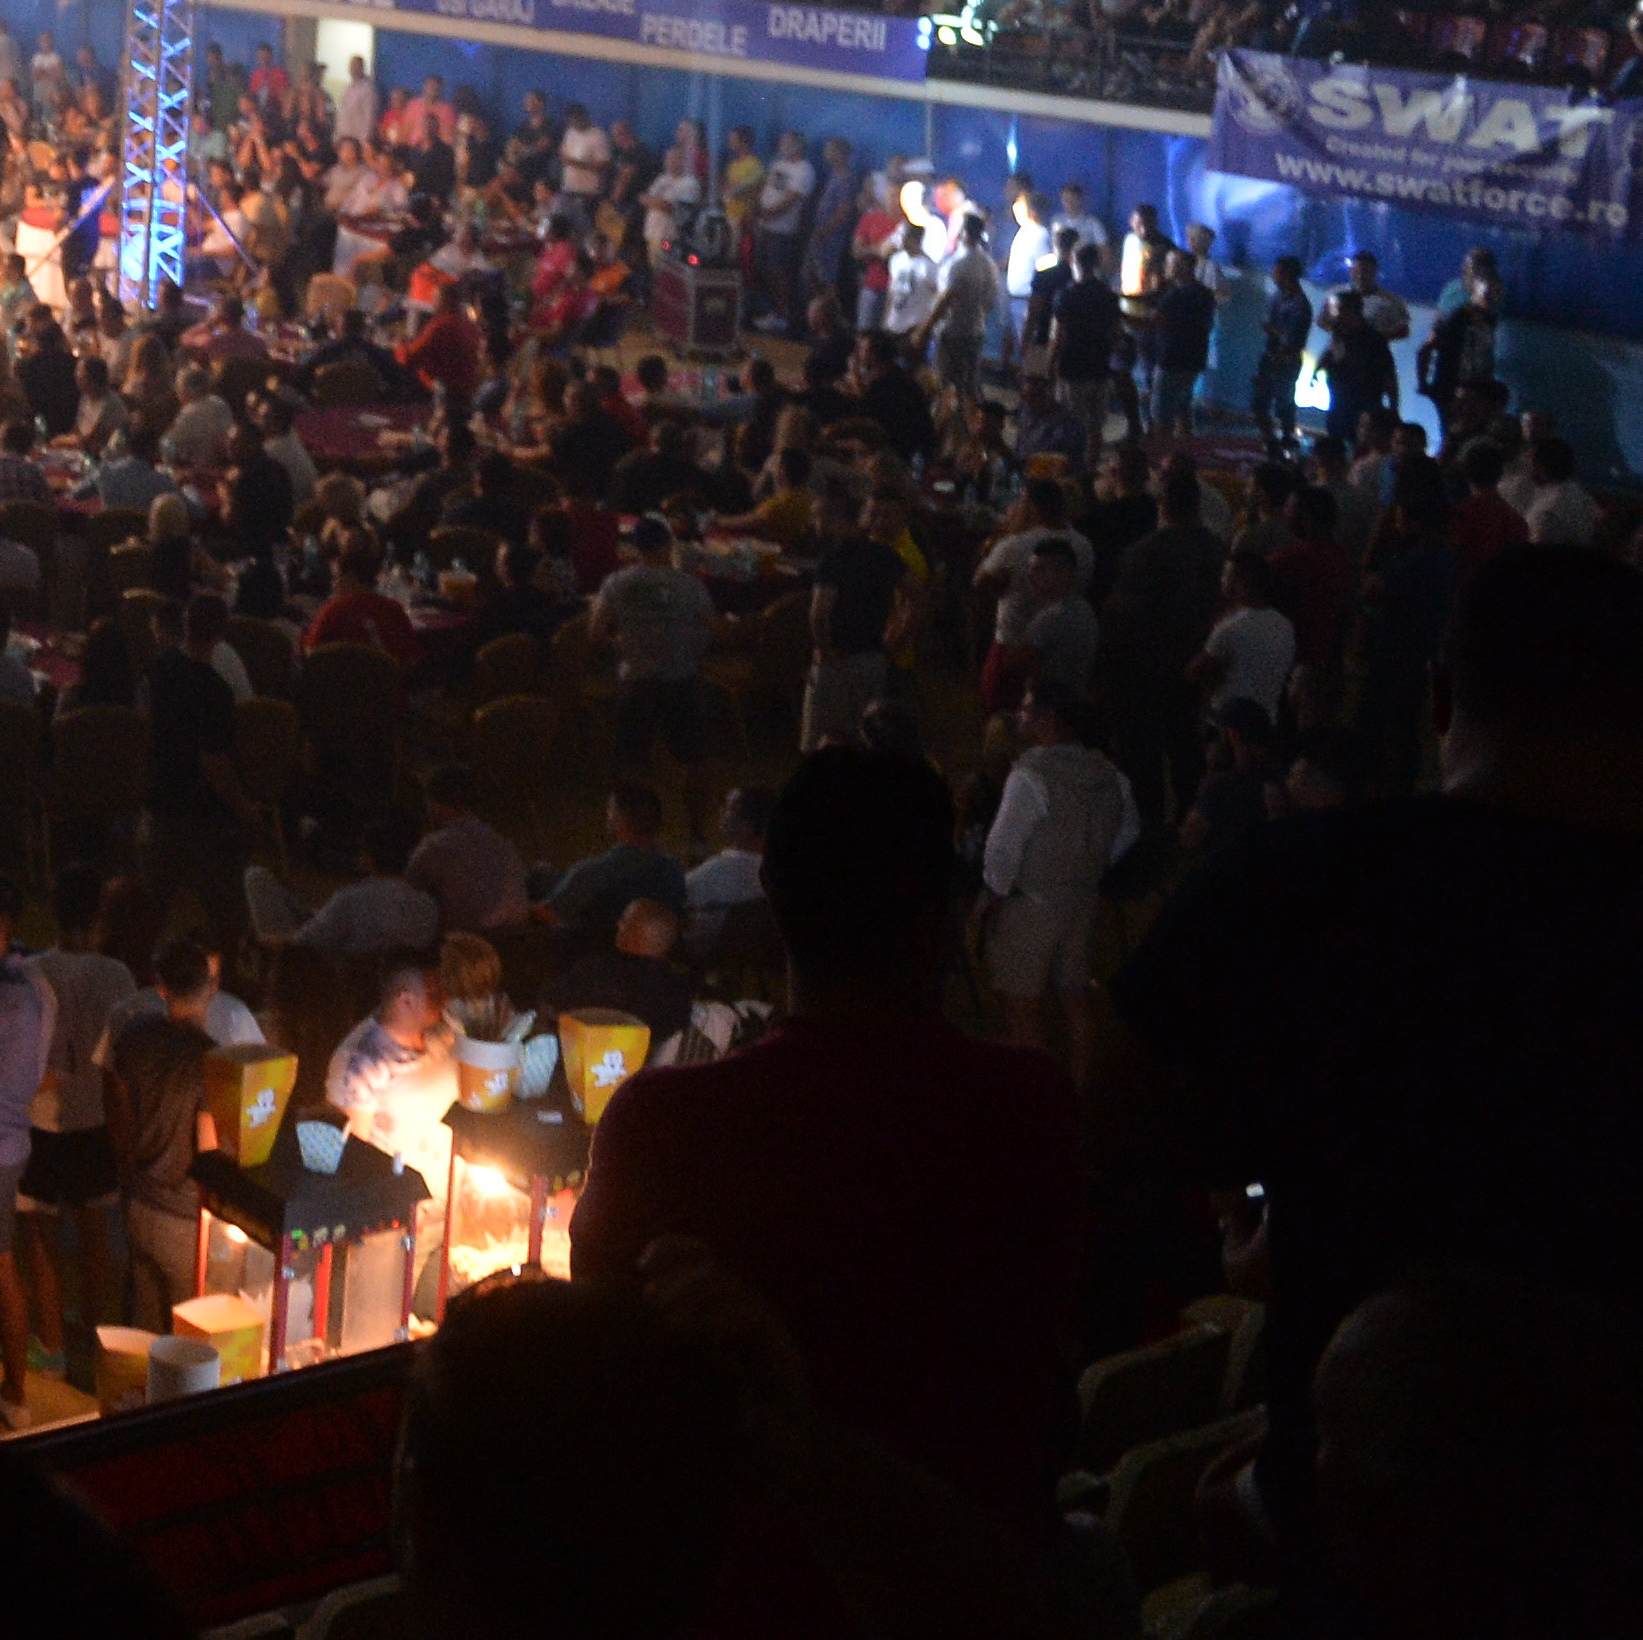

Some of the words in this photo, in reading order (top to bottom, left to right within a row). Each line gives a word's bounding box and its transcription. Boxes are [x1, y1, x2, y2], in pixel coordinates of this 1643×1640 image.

[639, 12, 749, 57] PERDELE
[767, 5, 887, 52] DRAPERII
[1307, 78, 1616, 160] SWAT
[1276, 153, 1629, 229] www.swatforce.ro
